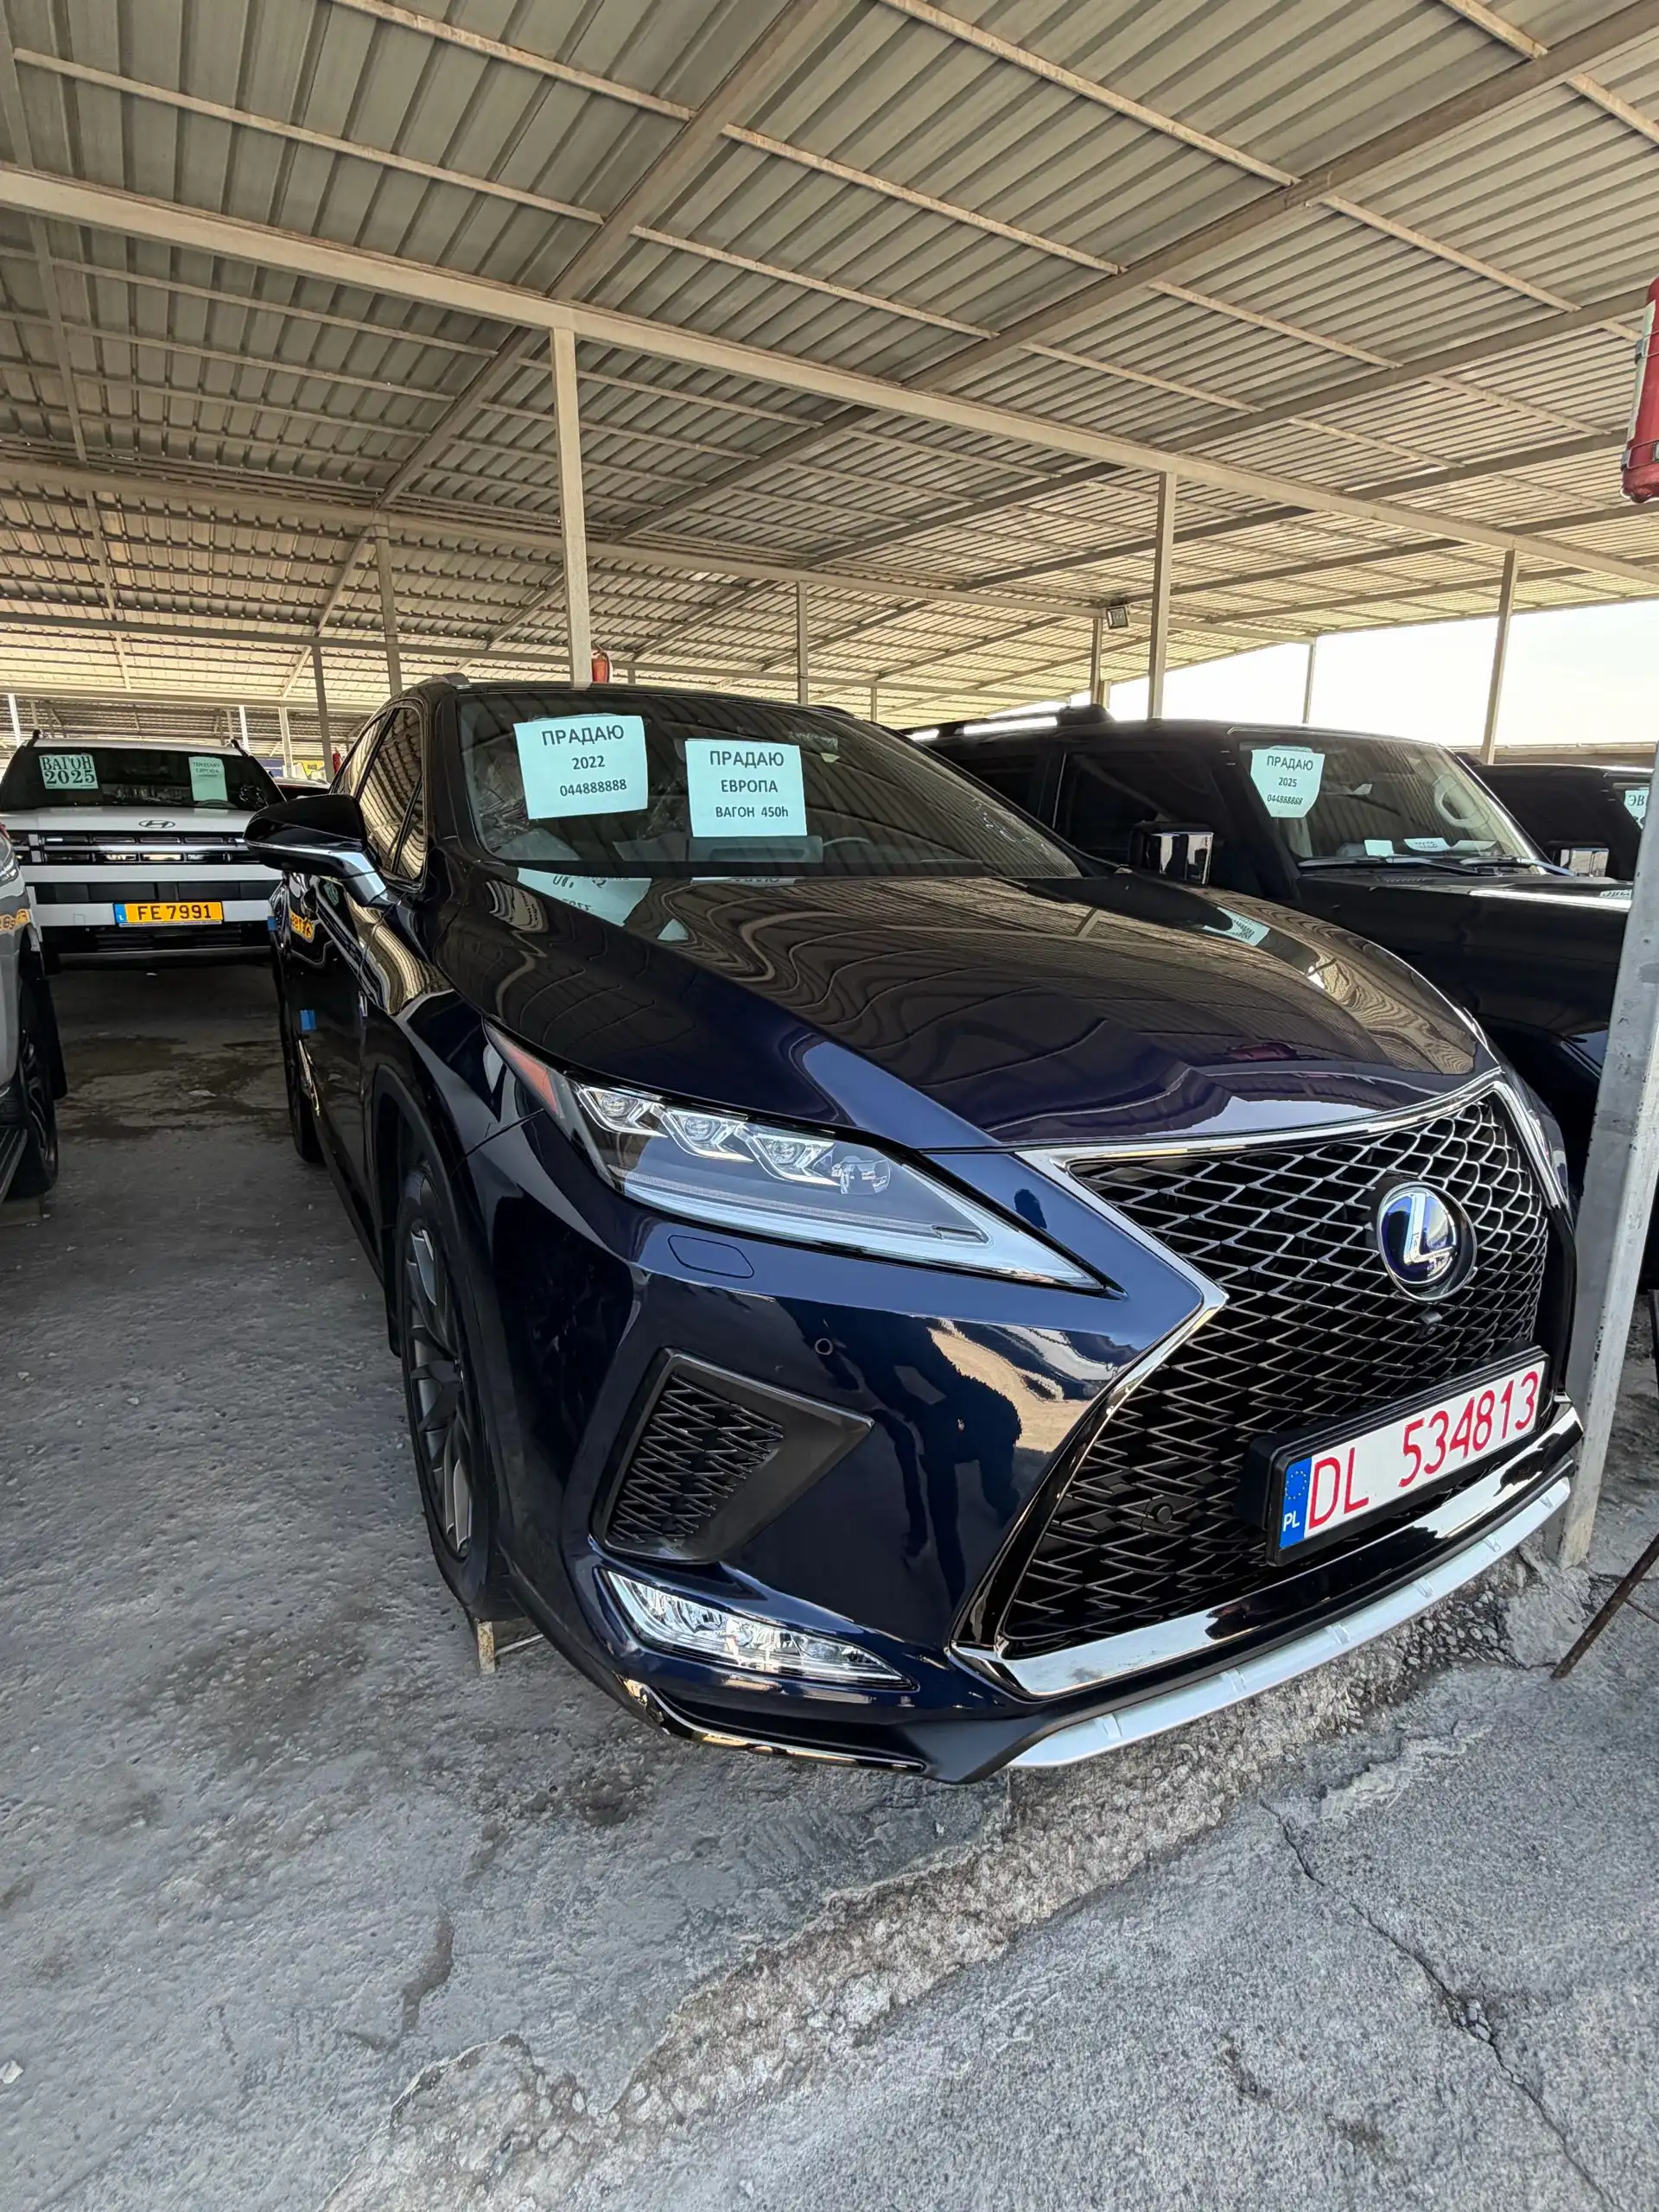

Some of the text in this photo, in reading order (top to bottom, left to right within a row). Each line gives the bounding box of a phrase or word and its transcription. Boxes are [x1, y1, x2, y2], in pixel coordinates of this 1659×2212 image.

[542, 724, 625, 746] ПРАДАЮ
[41, 756, 92, 770] ВАГОН
[572, 755, 606, 770] 2022
[709, 750, 785, 767] ПРАДАЮ
[1267, 755, 1313, 771] ПРАДАЮ
[44, 770, 95, 784] 2025
[1278, 777, 1298, 787] 2025
[560, 779, 627, 797] 044888888
[721, 779, 778, 794] ЕВРОПА
[715, 805, 789, 819] ВАГОН 450h
[137, 905, 212, 920] FE 7991
[1308, 1370, 1541, 1529] DL 534813
[1282, 1513, 1300, 1532] PL
